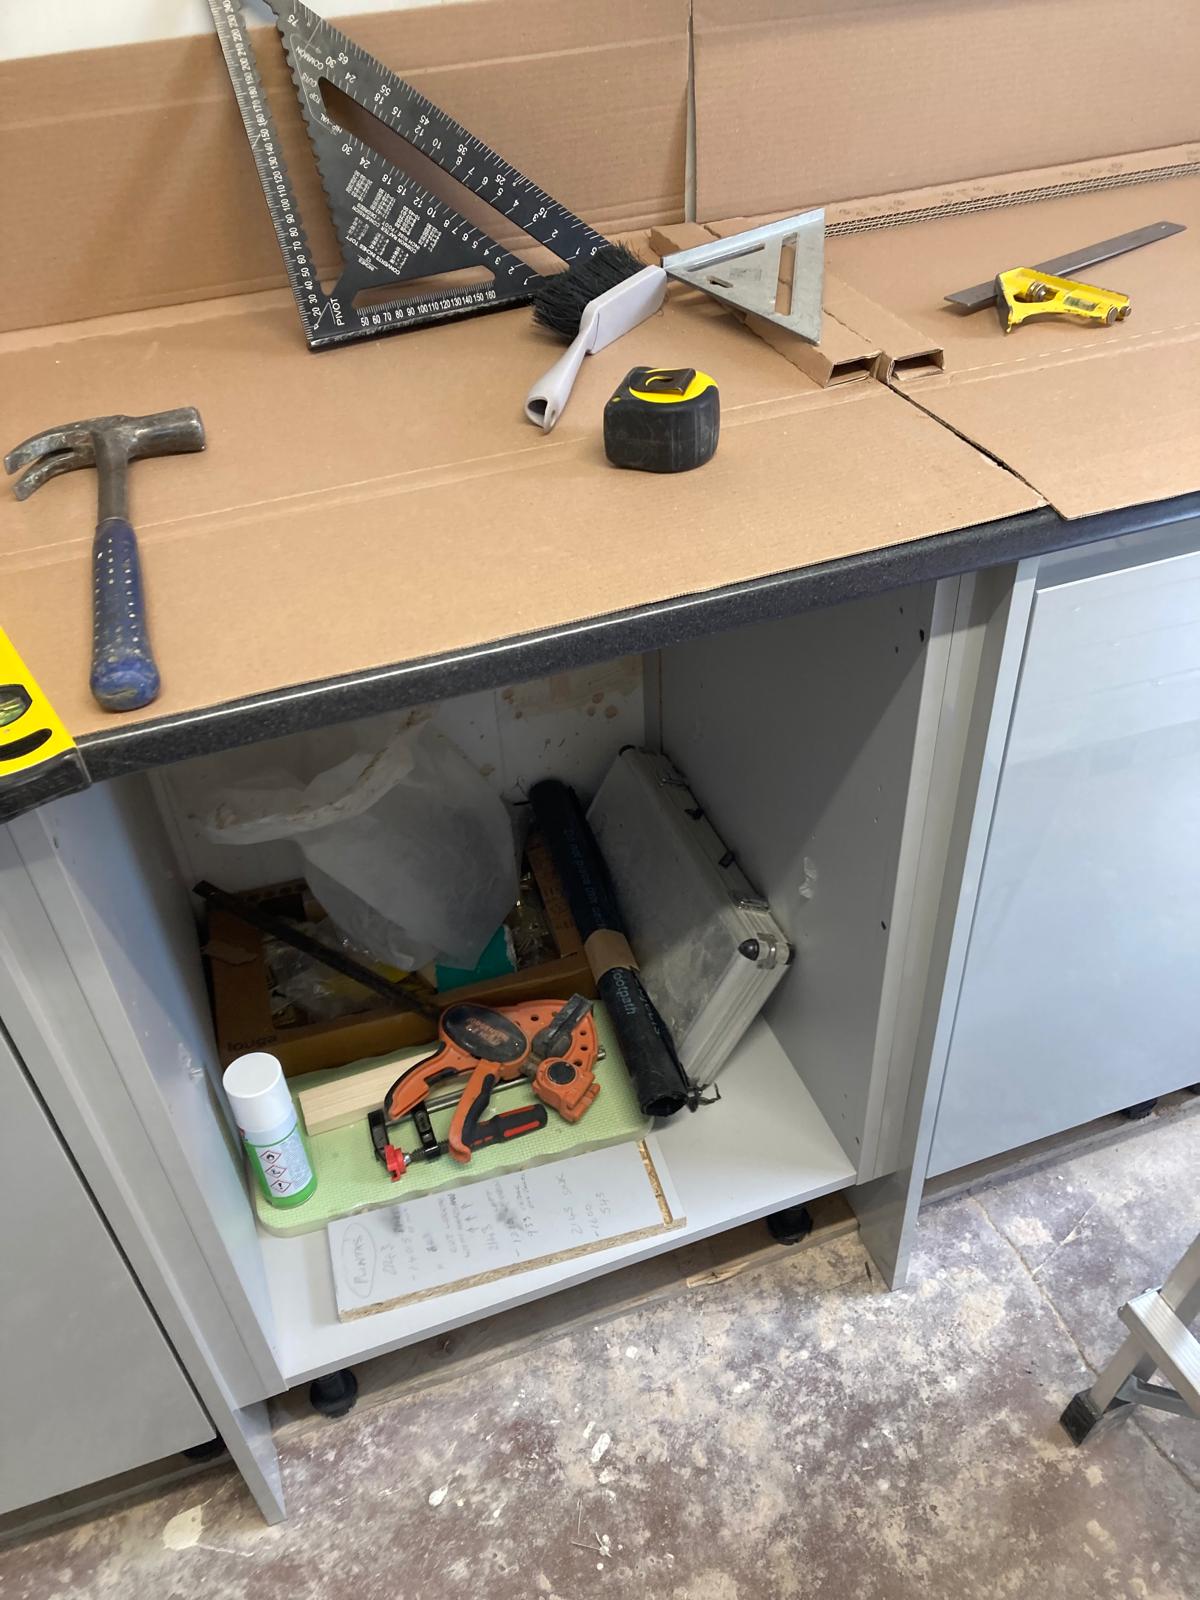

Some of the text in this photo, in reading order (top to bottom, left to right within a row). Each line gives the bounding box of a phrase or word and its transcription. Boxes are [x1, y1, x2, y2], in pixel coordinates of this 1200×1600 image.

[227, 14, 238, 28] 230
[232, 29, 242, 42] 220
[236, 43, 246, 56] 210
[296, 46, 324, 70] COMMON
[326, 56, 336, 68] 30
[240, 58, 250, 71] 200
[244, 72, 254, 84] 190
[345, 72, 356, 84] 24
[248, 86, 258, 98] 180
[310, 92, 320, 104] TOP
[374, 92, 384, 104] 18
[252, 100, 262, 112] 170
[392, 106, 402, 118] 15
[256, 114, 266, 126] 160
[260, 129, 270, 141] 150
[288, 14, 598, 256] 5 15 25 35 45 55 65 75
[414, 125, 424, 136] 12
[264, 142, 274, 156] 140
[342, 144, 352, 156] 30
[432, 138, 442, 150] 10
[268, 156, 278, 170] 130
[360, 157, 370, 168] 24
[456, 156, 462, 165] 8
[468, 166, 475, 175] 7
[273, 170, 282, 184] 120
[382, 174, 392, 185] 18
[482, 176, 488, 186] 6
[277, 184, 287, 197] 110
[397, 184, 406, 196] 15
[496, 188, 504, 196] 5
[281, 198, 290, 211] 100
[414, 196, 422, 208] 12
[426, 207, 436, 218] 10
[532, 214, 538, 222] 3
[285, 214, 296, 224] 90
[444, 220, 450, 228] 8
[289, 227, 298, 237] 80
[462, 233, 468, 242] 6
[552, 229, 558, 238] 2
[292, 241, 302, 250] 70
[472, 240, 478, 248] 5
[297, 254, 306, 264] 60
[301, 268, 310, 277] 50
[508, 266, 514, 274] 2
[304, 280, 313, 290] 40
[308, 294, 318, 304] 30
[312, 307, 322, 316] 20
[330, 298, 345, 326] PIVOT
[361, 290, 496, 326] 50 60 70 80 90 100 110 120 130 140 150 160
